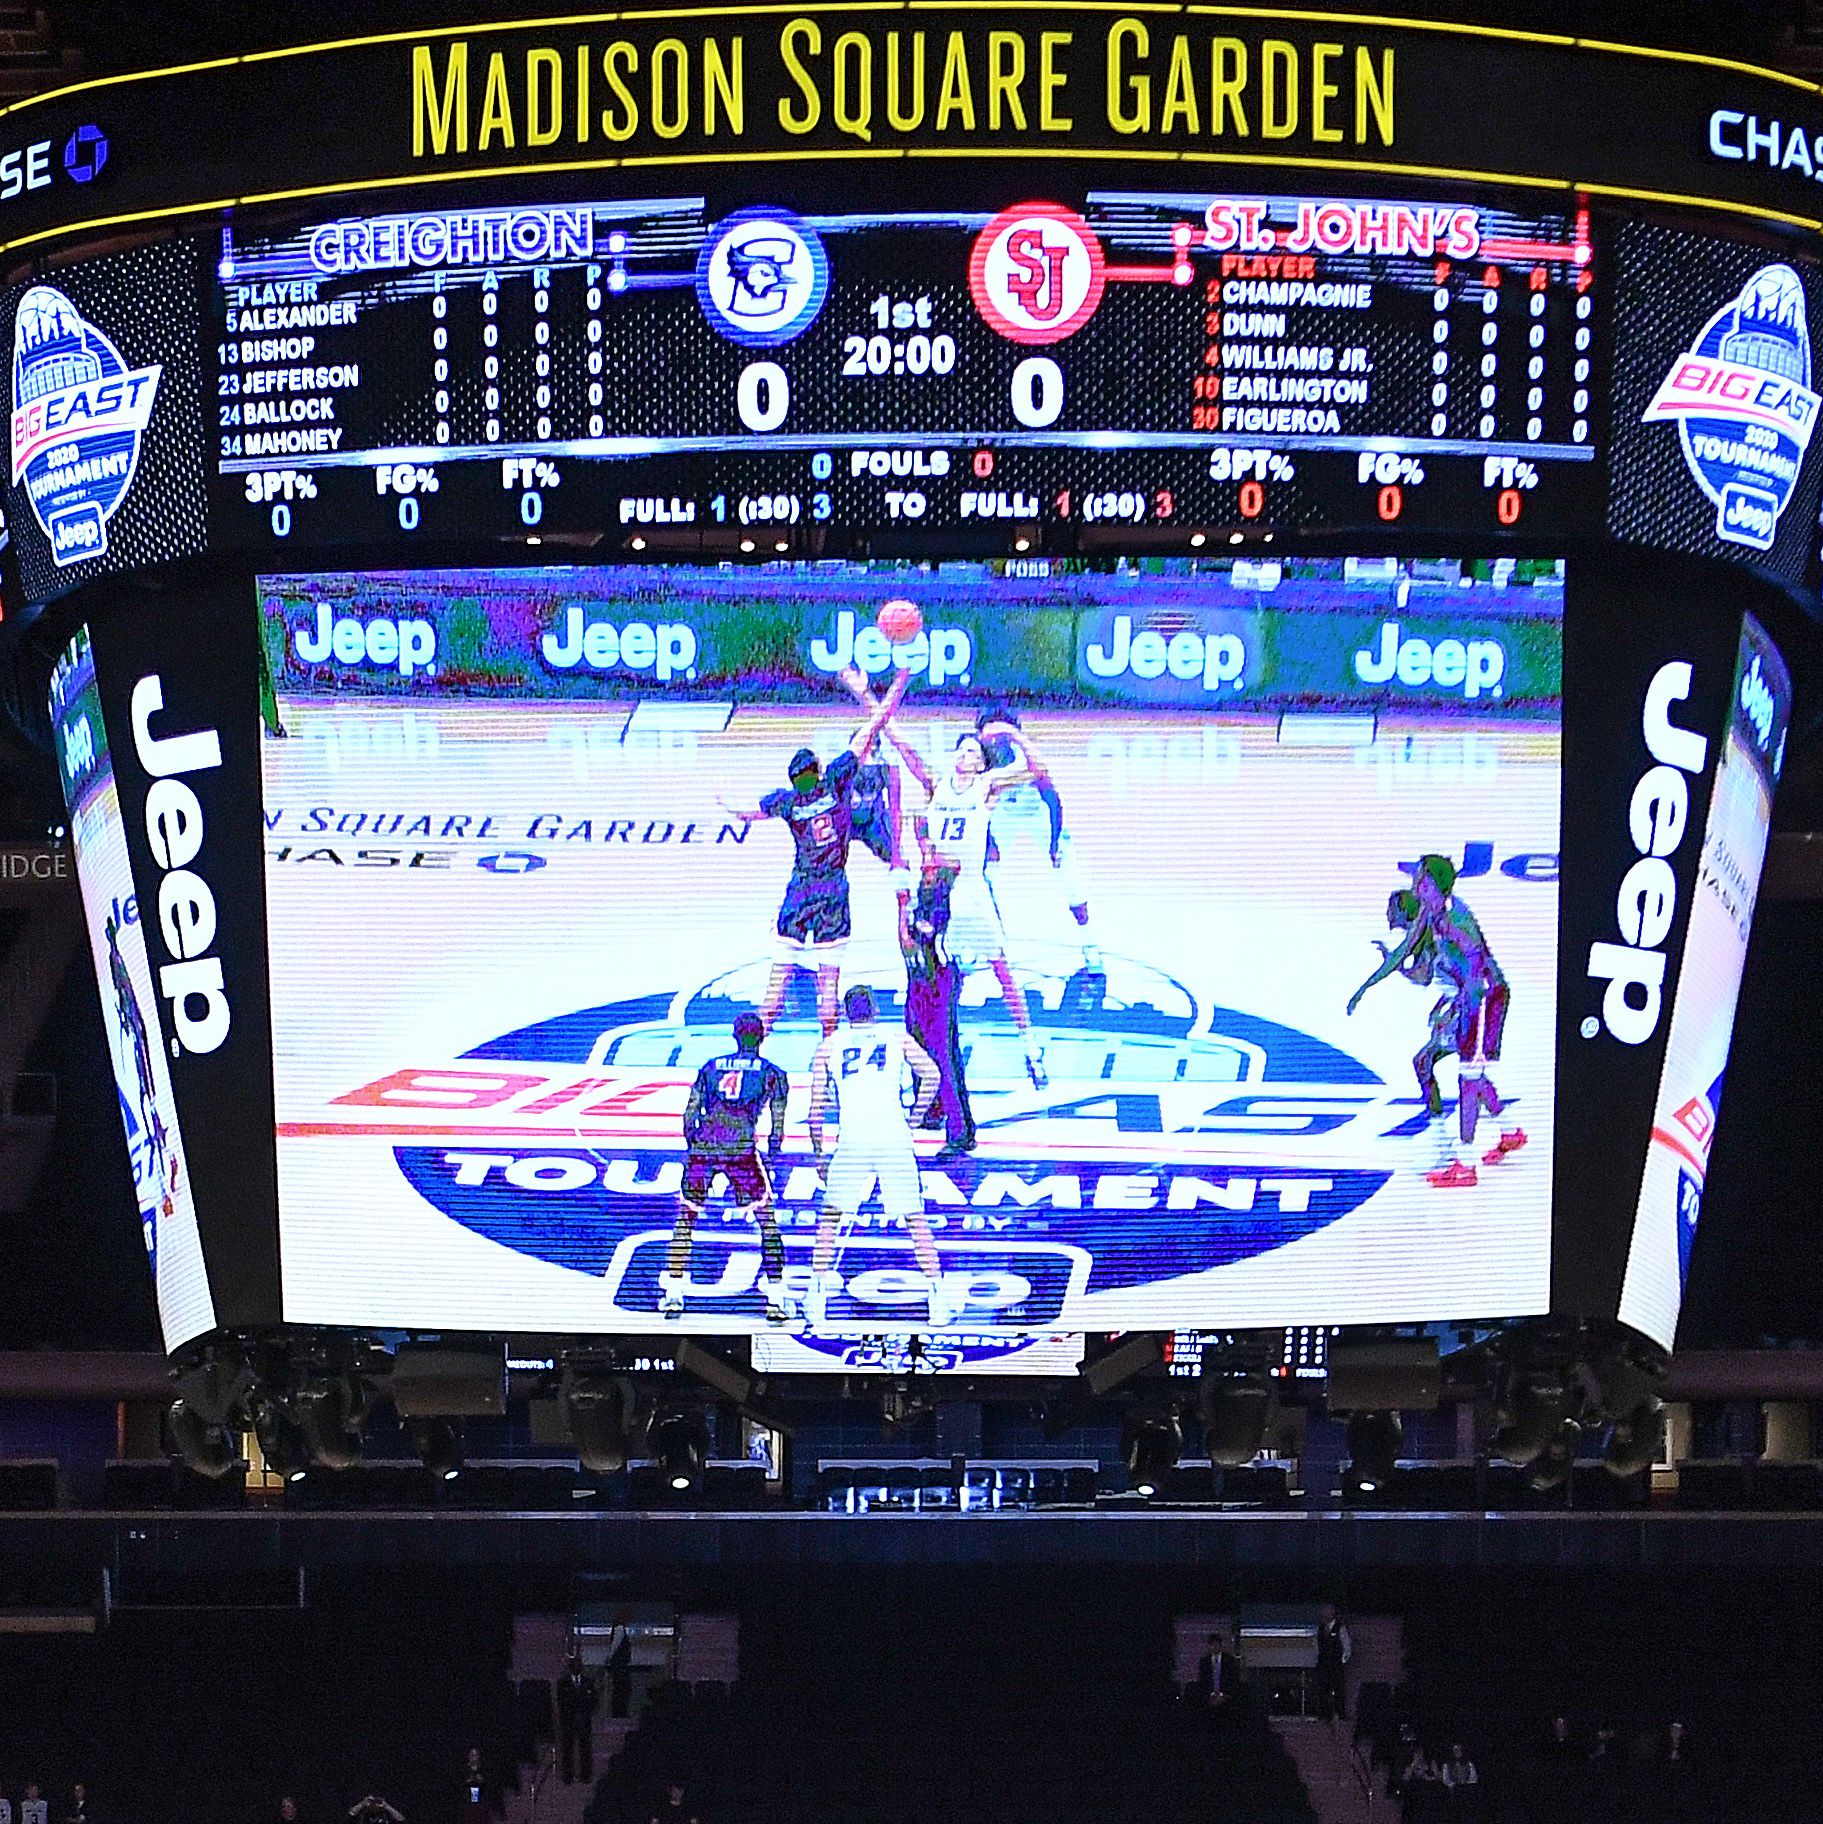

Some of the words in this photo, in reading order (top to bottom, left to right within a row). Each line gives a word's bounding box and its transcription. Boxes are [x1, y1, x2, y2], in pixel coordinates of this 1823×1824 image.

[411, 36, 746, 158] MADISON
[777, 18, 1073, 145] SQUARE
[1105, 18, 1396, 147] GARDEN
[310, 208, 594, 273] CREIGHTON
[1203, 199, 1277, 251] ST.
[1287, 202, 1481, 260] JOHN'S
[1221, 254, 1316, 279] PLAYER
[238, 281, 318, 306] PLAYER
[434, 273, 446, 292] F
[482, 271, 499, 291] A
[533, 267, 551, 288] R
[586, 265, 601, 286] P
[1221, 280, 1373, 309] CHAMPAGNIE
[226, 311, 237, 332] 5
[239, 303, 358, 332] ALEXANDER
[869, 295, 932, 330] 1st
[1222, 312, 1286, 338] DUNN
[218, 343, 239, 364] 13
[241, 336, 315, 364] BISHOP
[842, 334, 957, 376] 20:00
[1221, 345, 1334, 372] WILLIAMS
[1337, 348, 1375, 373] JR.
[218, 375, 240, 395] 23
[242, 365, 359, 394] JEFFERSON
[736, 360, 790, 432] 0
[1010, 356, 1064, 429] 0
[1222, 376, 1368, 404] EARLINGTON
[1671, 363, 1757, 401] BIG
[1752, 379, 1815, 427] EAST
[45, 376, 151, 432] EAST
[220, 405, 241, 426] 24
[243, 398, 335, 425] BALLOCK
[1222, 407, 1341, 434] FIGUEROA
[221, 435, 242, 456] 34
[244, 428, 343, 456] MAHONEY
[30, 451, 130, 501] TOURNAMENT
[376, 464, 440, 495] FG%
[502, 457, 561, 489] FT%
[812, 452, 833, 479] 0
[850, 450, 951, 477] FOULS
[973, 450, 995, 478] 0
[1209, 447, 1295, 483] 3PT%
[1358, 453, 1425, 486] FG%
[1483, 456, 1540, 489] FT%
[245, 470, 318, 502] 3PT%
[1239, 480, 1265, 519] 0
[398, 497, 420, 531] 0
[520, 491, 543, 525] 0
[619, 497, 696, 524] FULL:
[711, 495, 726, 523] 1
[812, 494, 832, 520] 3
[885, 492, 927, 519] TO
[960, 491, 1040, 519] FULL:
[1056, 490, 1070, 519] 1
[1156, 491, 1173, 518] 3
[1377, 484, 1403, 522] 0
[1496, 488, 1522, 526] 0
[271, 504, 292, 537] 0
[810, 817, 832, 844] 2
[939, 817, 966, 842] 13
[718, 1071, 742, 1100] 4
[842, 1043, 887, 1080] 24
